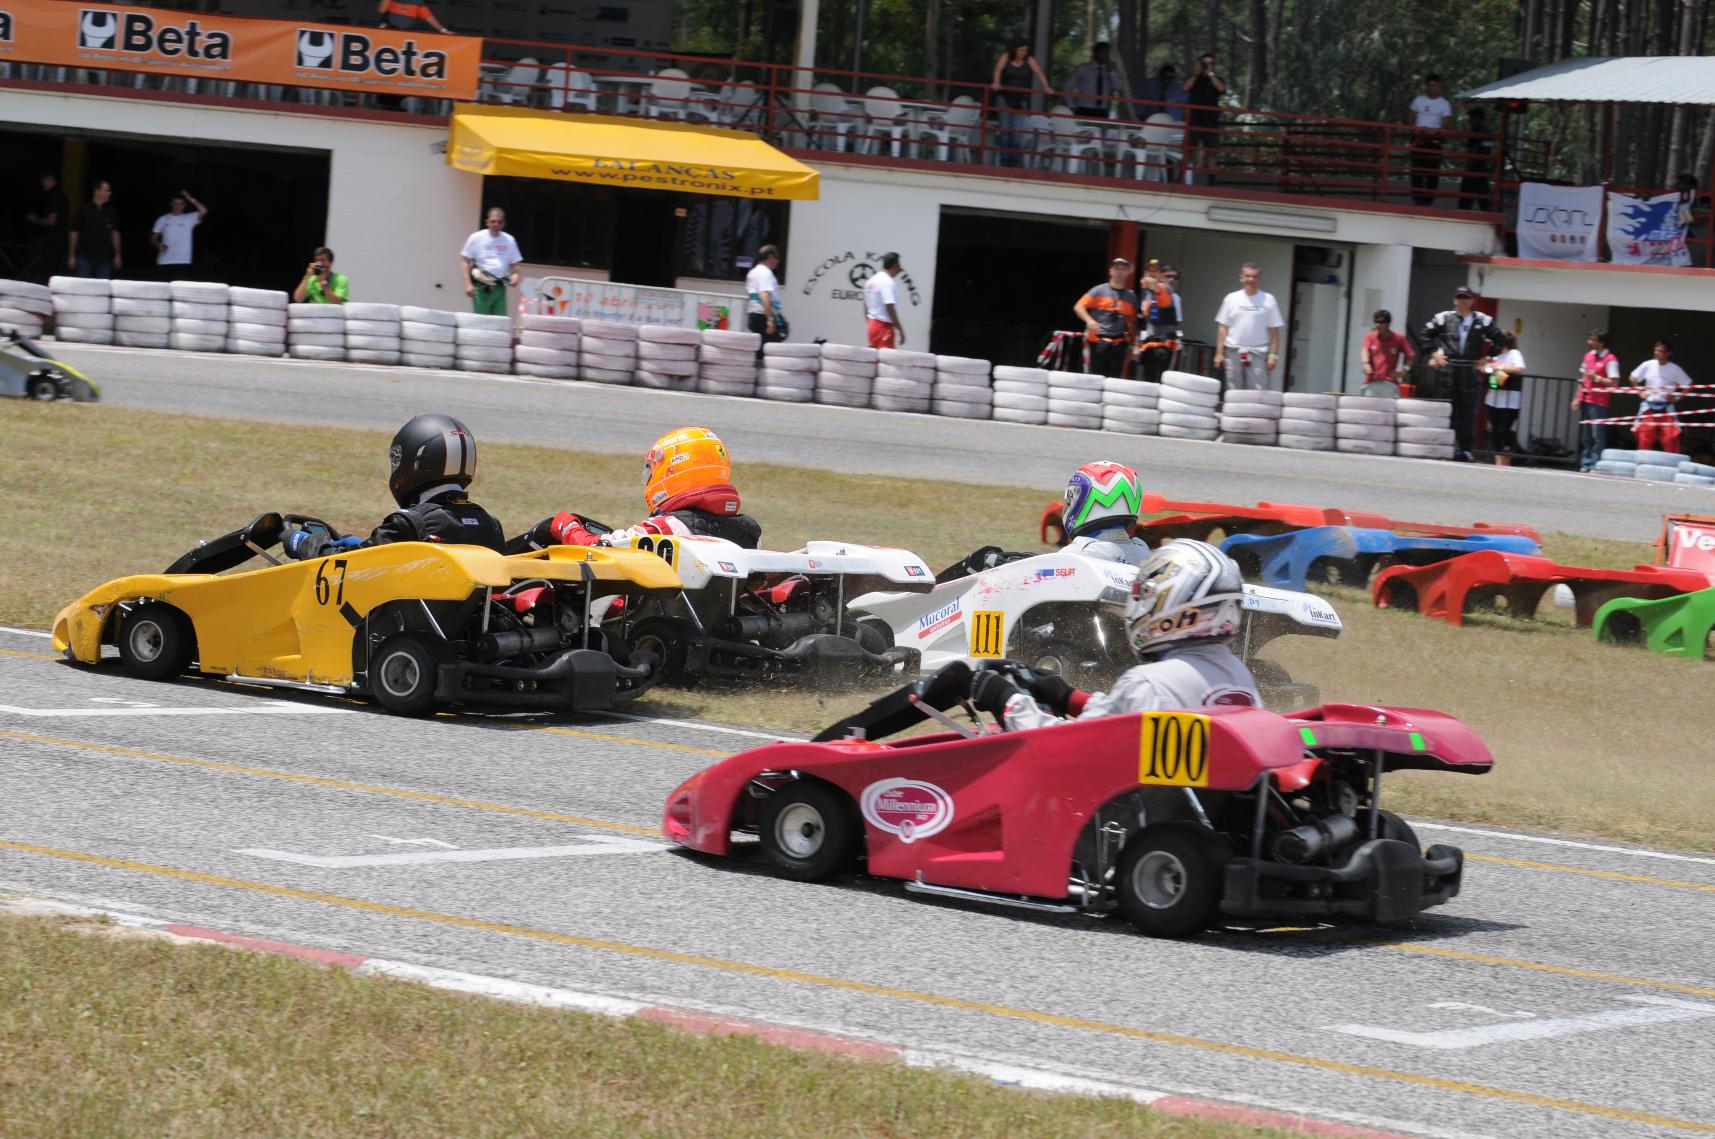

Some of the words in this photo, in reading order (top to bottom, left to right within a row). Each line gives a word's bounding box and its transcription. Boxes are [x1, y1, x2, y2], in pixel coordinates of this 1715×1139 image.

[123, 13, 230, 60] Beta
[340, 33, 446, 78] Beta
[551, 167, 775, 196] www.pestronix.pt
[803, 251, 856, 296] ESCOLA
[315, 559, 348, 606] 67
[918, 596, 960, 631] Mucoral
[973, 612, 1001, 655] 111
[1144, 716, 1207, 782] 100
[876, 797, 938, 812] Millennium
